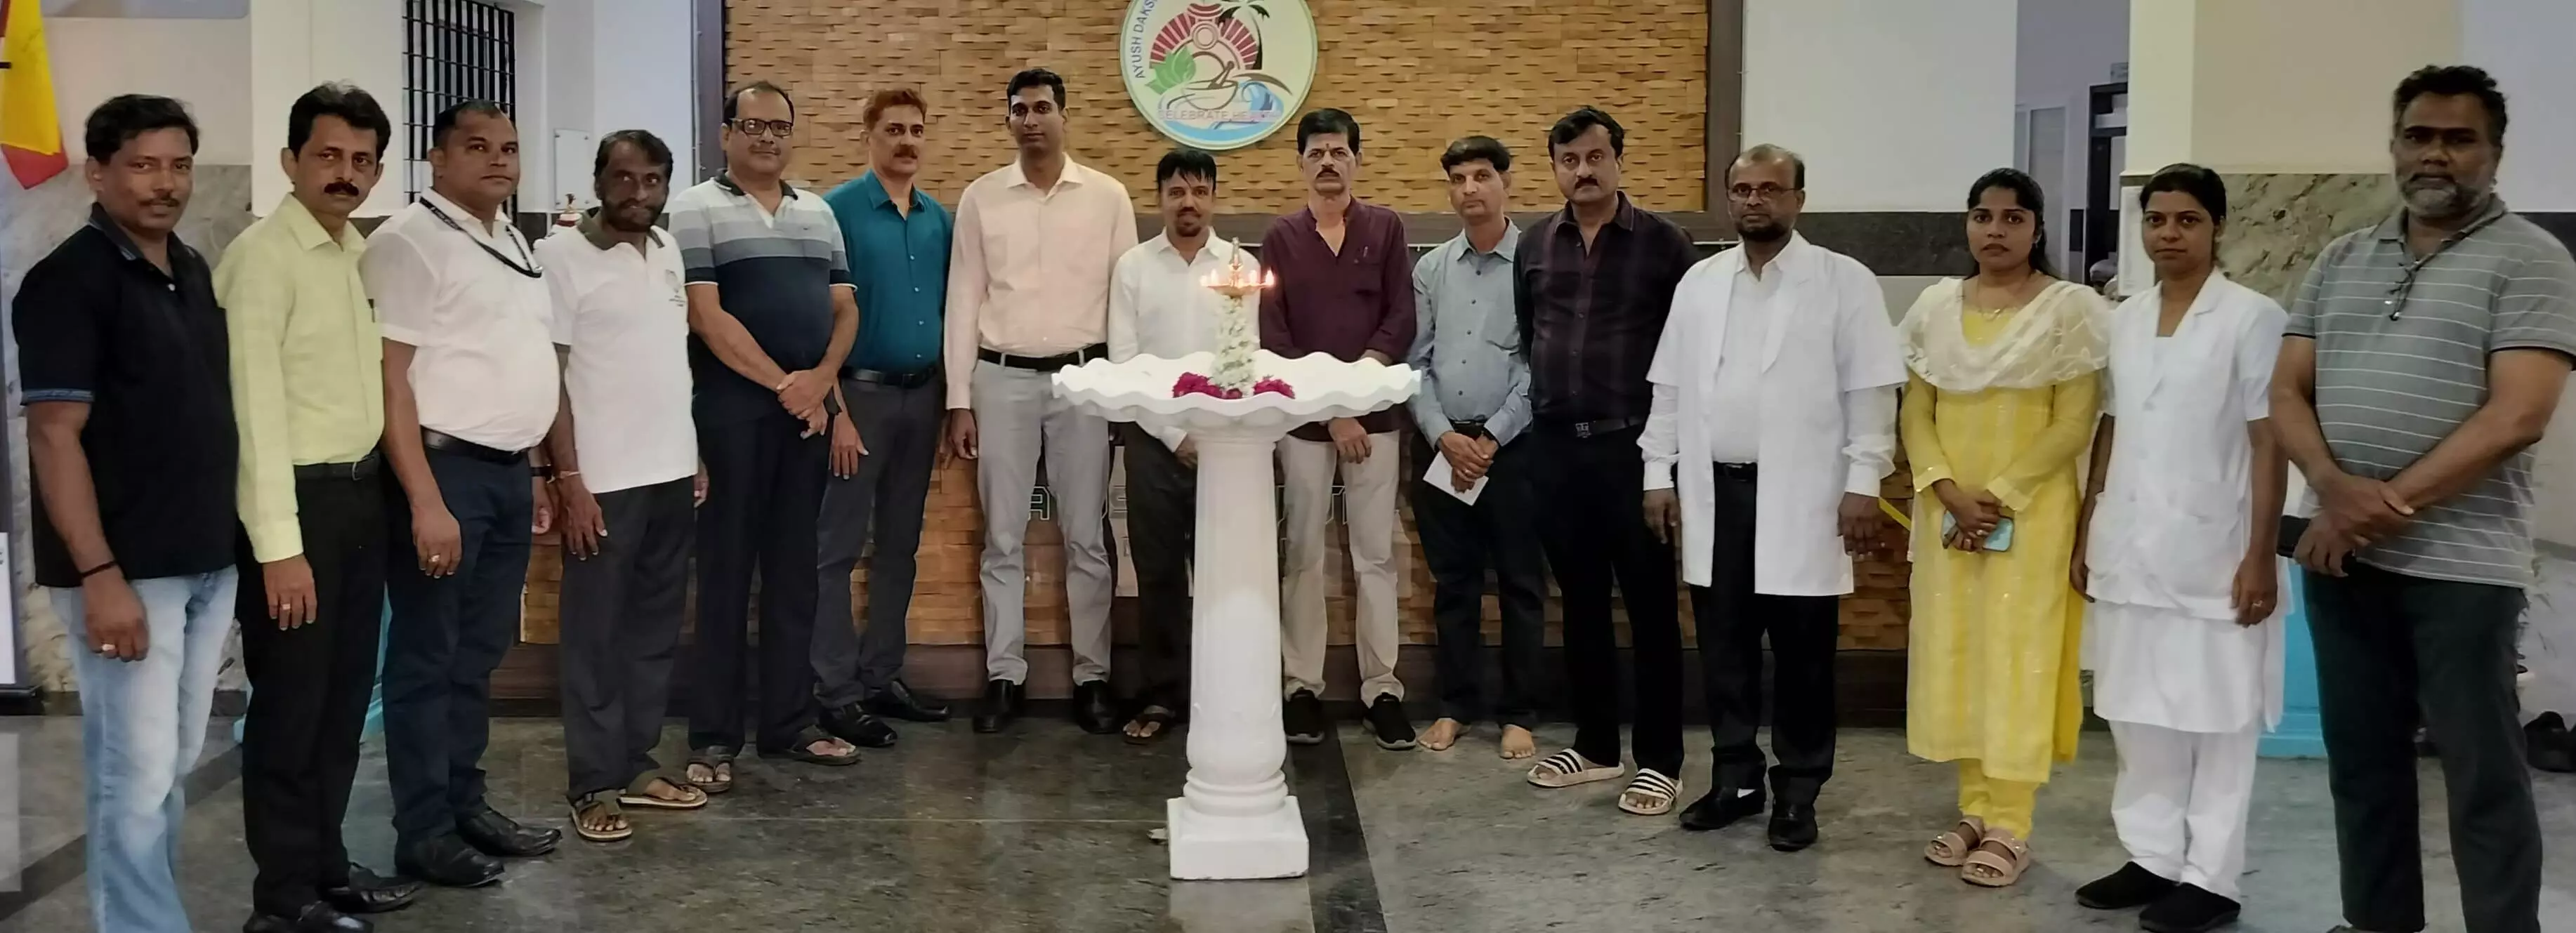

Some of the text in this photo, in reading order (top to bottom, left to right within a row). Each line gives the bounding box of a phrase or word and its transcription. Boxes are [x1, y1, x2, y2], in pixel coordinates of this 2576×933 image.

[1131, 0, 1157, 79] AYUSH DAKS
[1157, 110, 1229, 120] CELEBRATE
